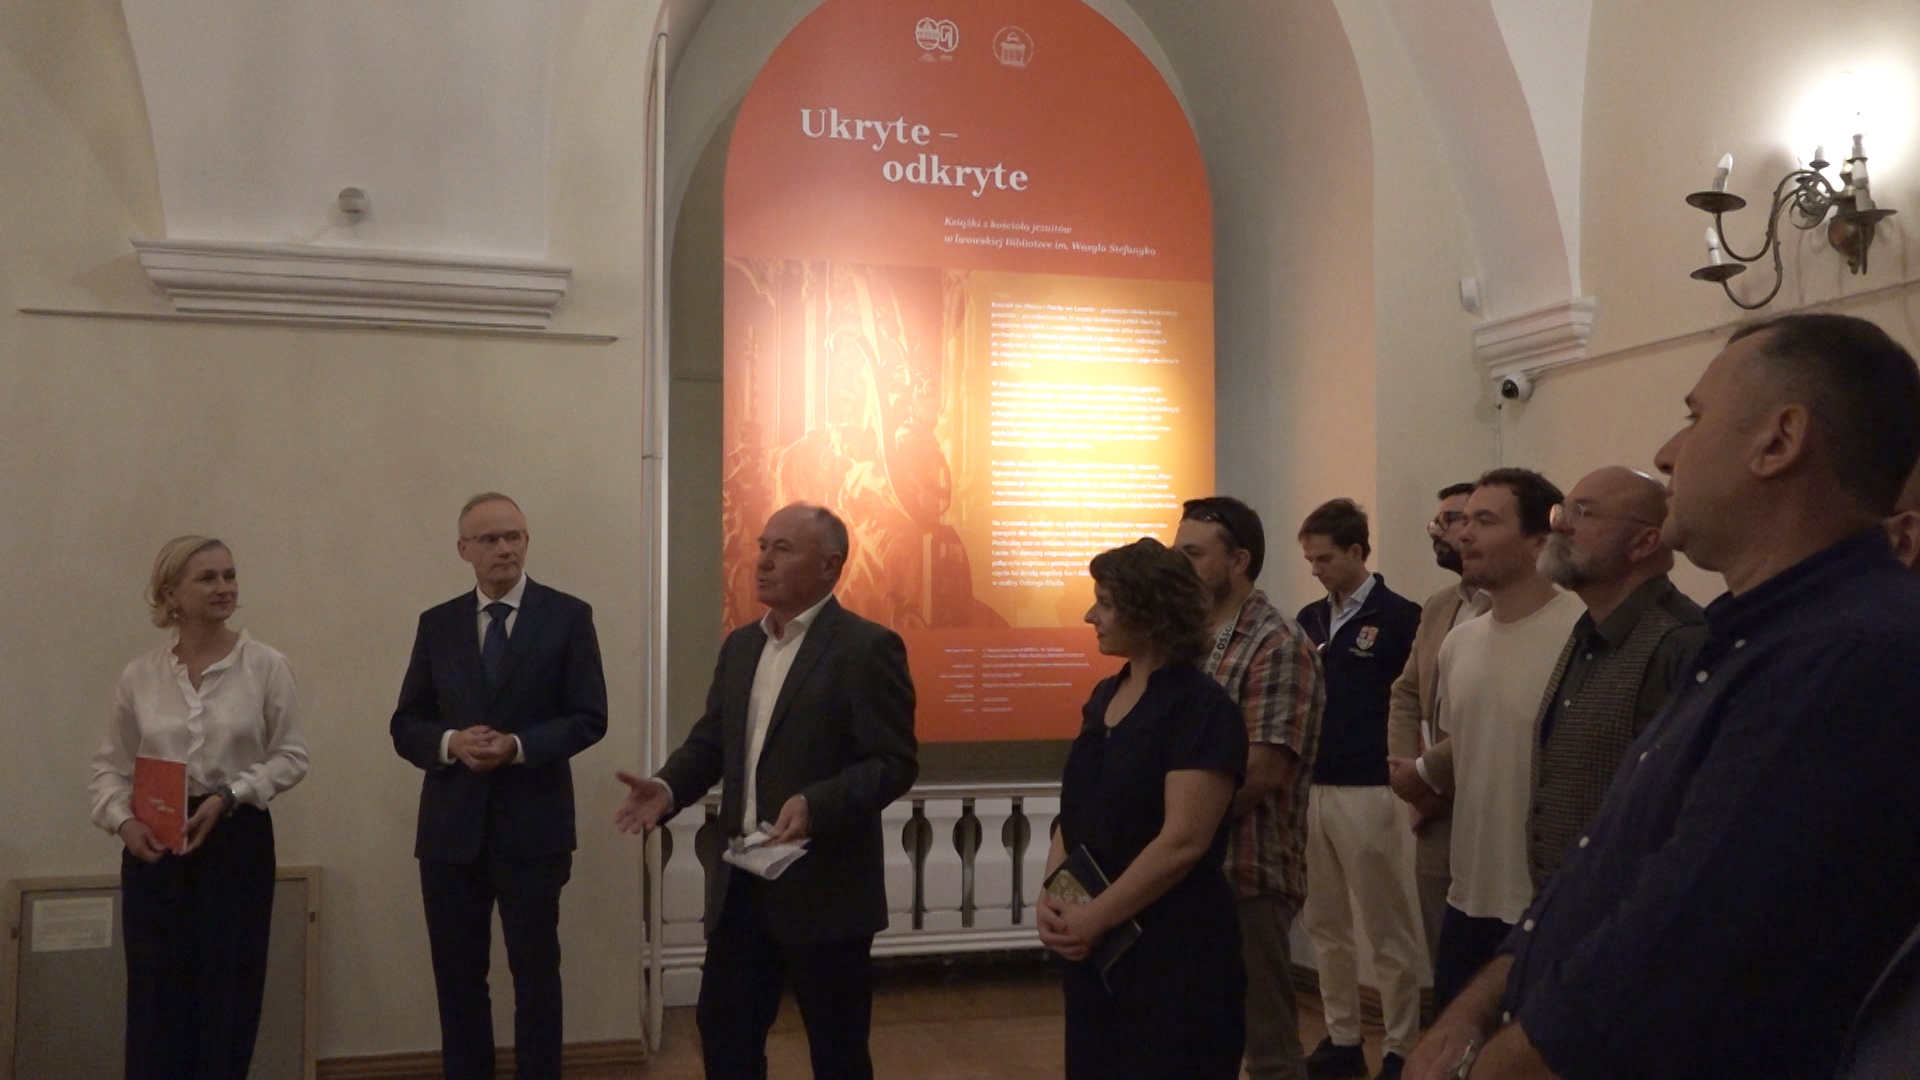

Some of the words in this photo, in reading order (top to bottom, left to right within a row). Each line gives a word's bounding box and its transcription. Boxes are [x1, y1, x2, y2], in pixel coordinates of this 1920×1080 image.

[800, 107, 931, 152] Ukryte
[882, 153, 1030, 197] odkryte
[944, 235, 953, 243] w
[955, 234, 1003, 248] lwowskiej
[1055, 239, 1069, 250] im.
[1071, 241, 1107, 255] Wasyla
